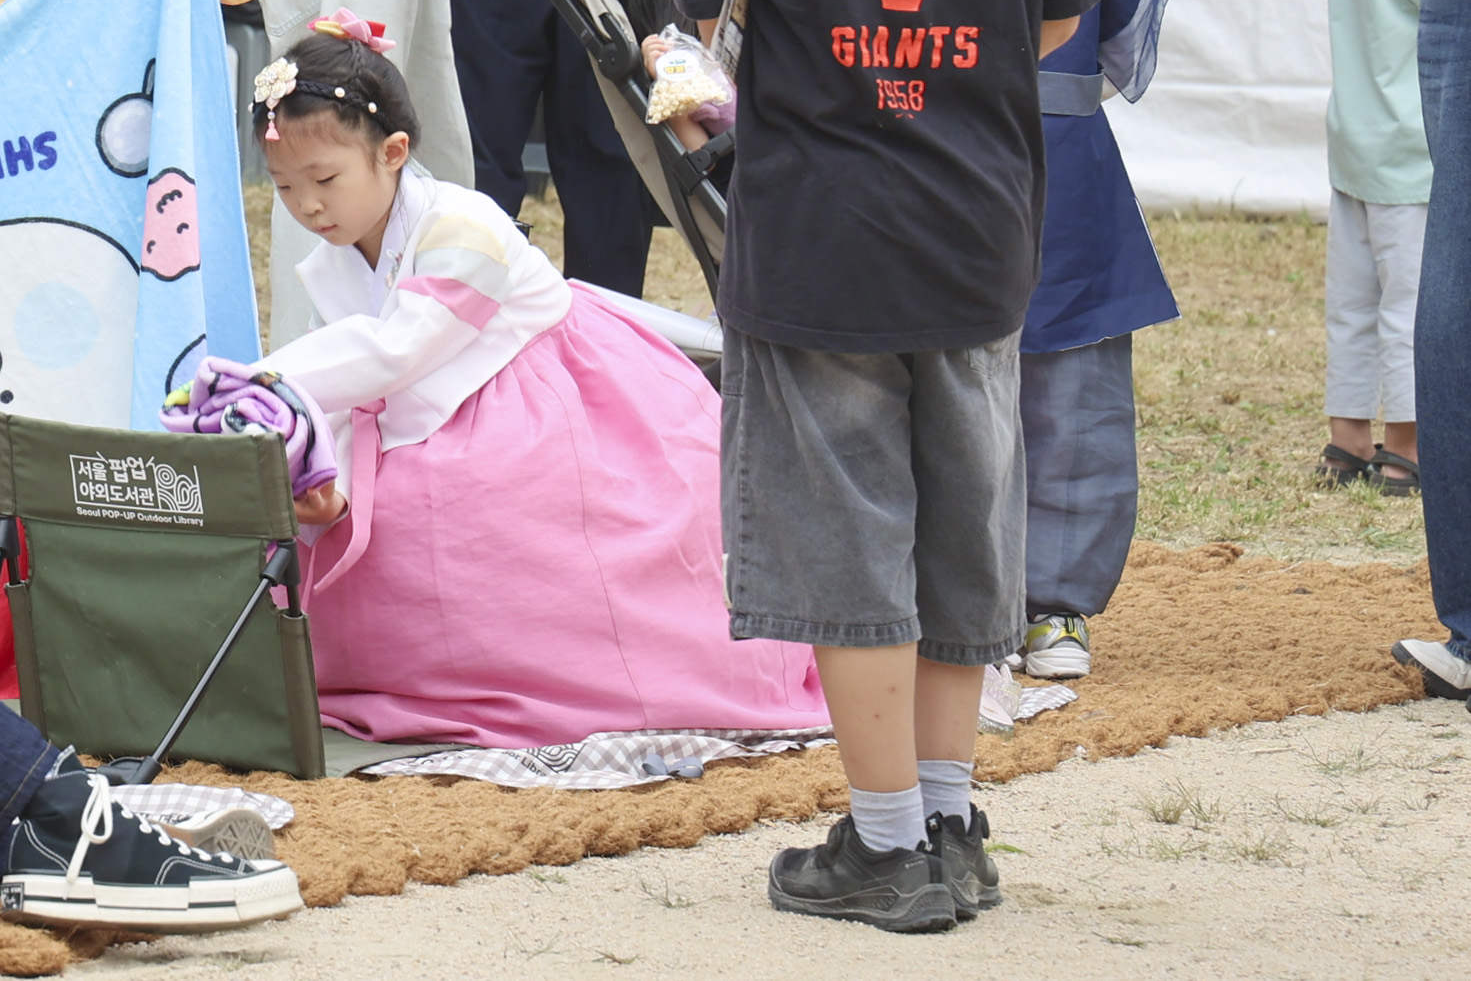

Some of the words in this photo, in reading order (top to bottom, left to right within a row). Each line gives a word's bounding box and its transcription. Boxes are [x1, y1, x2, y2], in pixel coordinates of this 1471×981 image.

[831, 25, 980, 69] GIANTS
[876, 79, 926, 112] 1958
[78, 461, 108, 482] 서울
[108, 456, 147, 484] 팝업
[79, 481, 155, 507] 야외도서관
[76, 506, 101, 518] Seoul
[102, 509, 136, 521] POP-UP
[137, 513, 173, 524] Outdoor
[173, 515, 204, 527] Library
[520, 757, 548, 777] Libra
